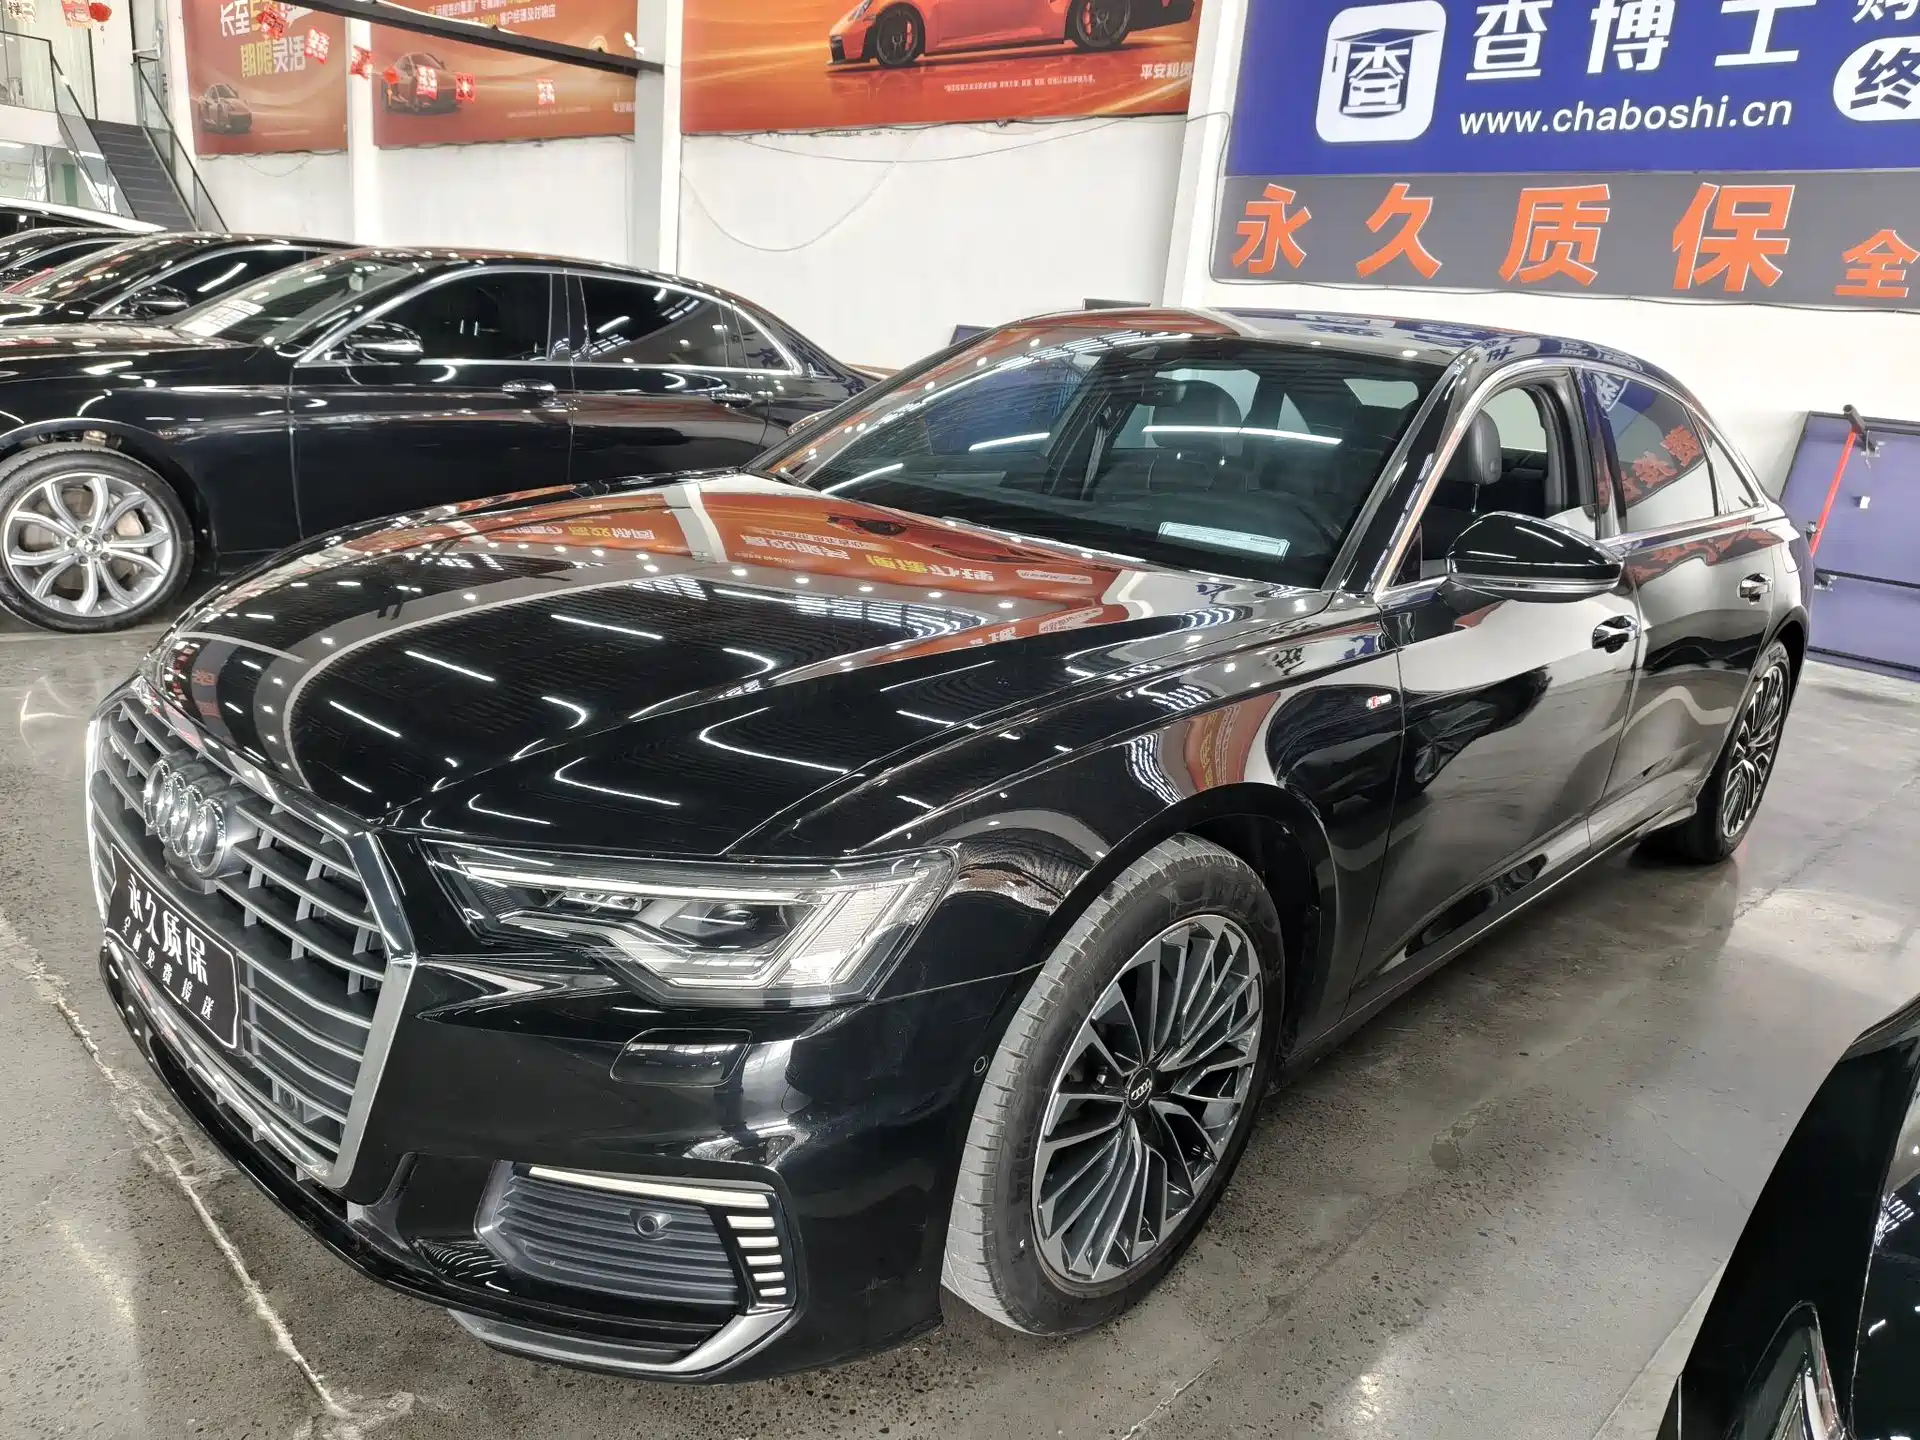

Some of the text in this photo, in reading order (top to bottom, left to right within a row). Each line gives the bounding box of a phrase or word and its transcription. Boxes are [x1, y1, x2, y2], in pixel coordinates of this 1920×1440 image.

[1466, 0, 1818, 81] 查博士
[1459, 95, 1794, 135] www.chaboshi.cn
[1231, 182, 1918, 299] 永久质保 全
[127, 873, 208, 986] 永久质保
